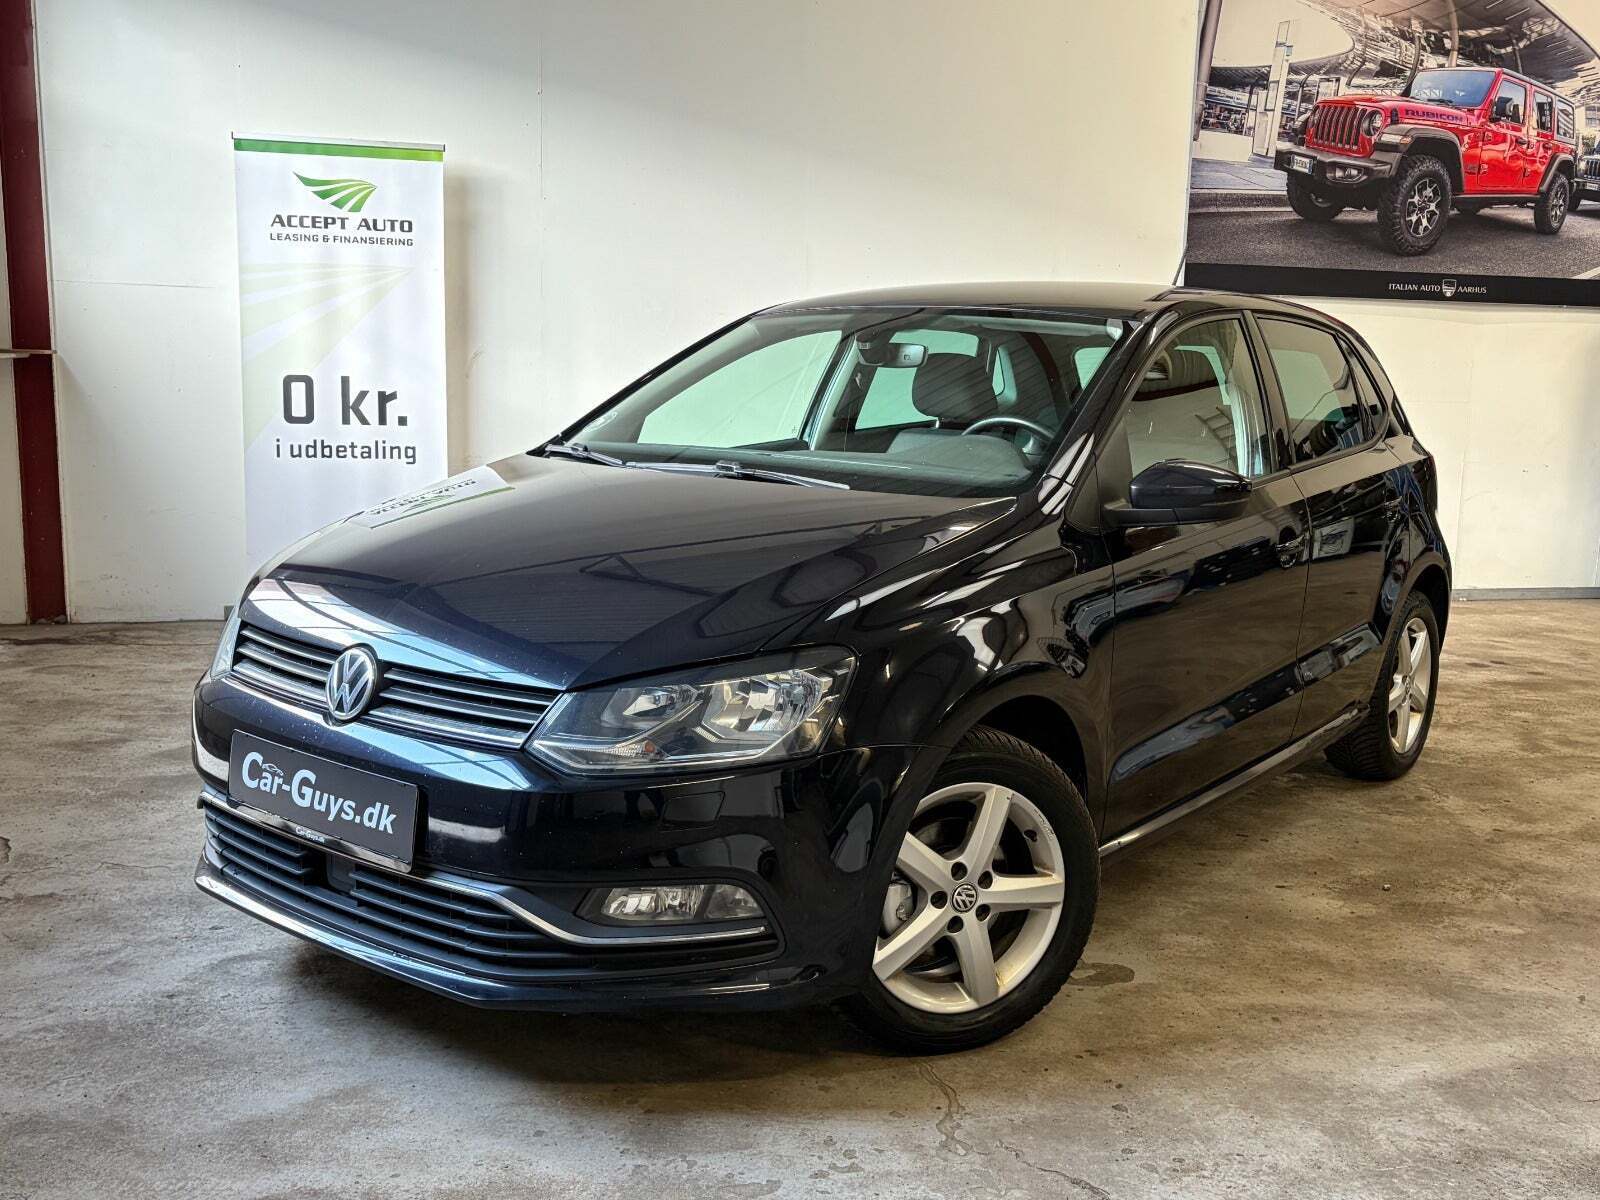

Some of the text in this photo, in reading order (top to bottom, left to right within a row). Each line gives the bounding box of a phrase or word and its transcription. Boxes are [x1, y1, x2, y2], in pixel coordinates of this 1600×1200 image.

[1405, 109, 1463, 121] RUBICON
[271, 214, 413, 233] ACCEPT AUTO
[269, 232, 414, 247] LEASING & FINANSIERING
[1388, 283, 1487, 294] ITALIAN AUTO AARHUS
[282, 374, 408, 426] 0 kr.
[275, 438, 416, 465] i udbetaling
[241, 751, 398, 835] Car-Guys.dk
